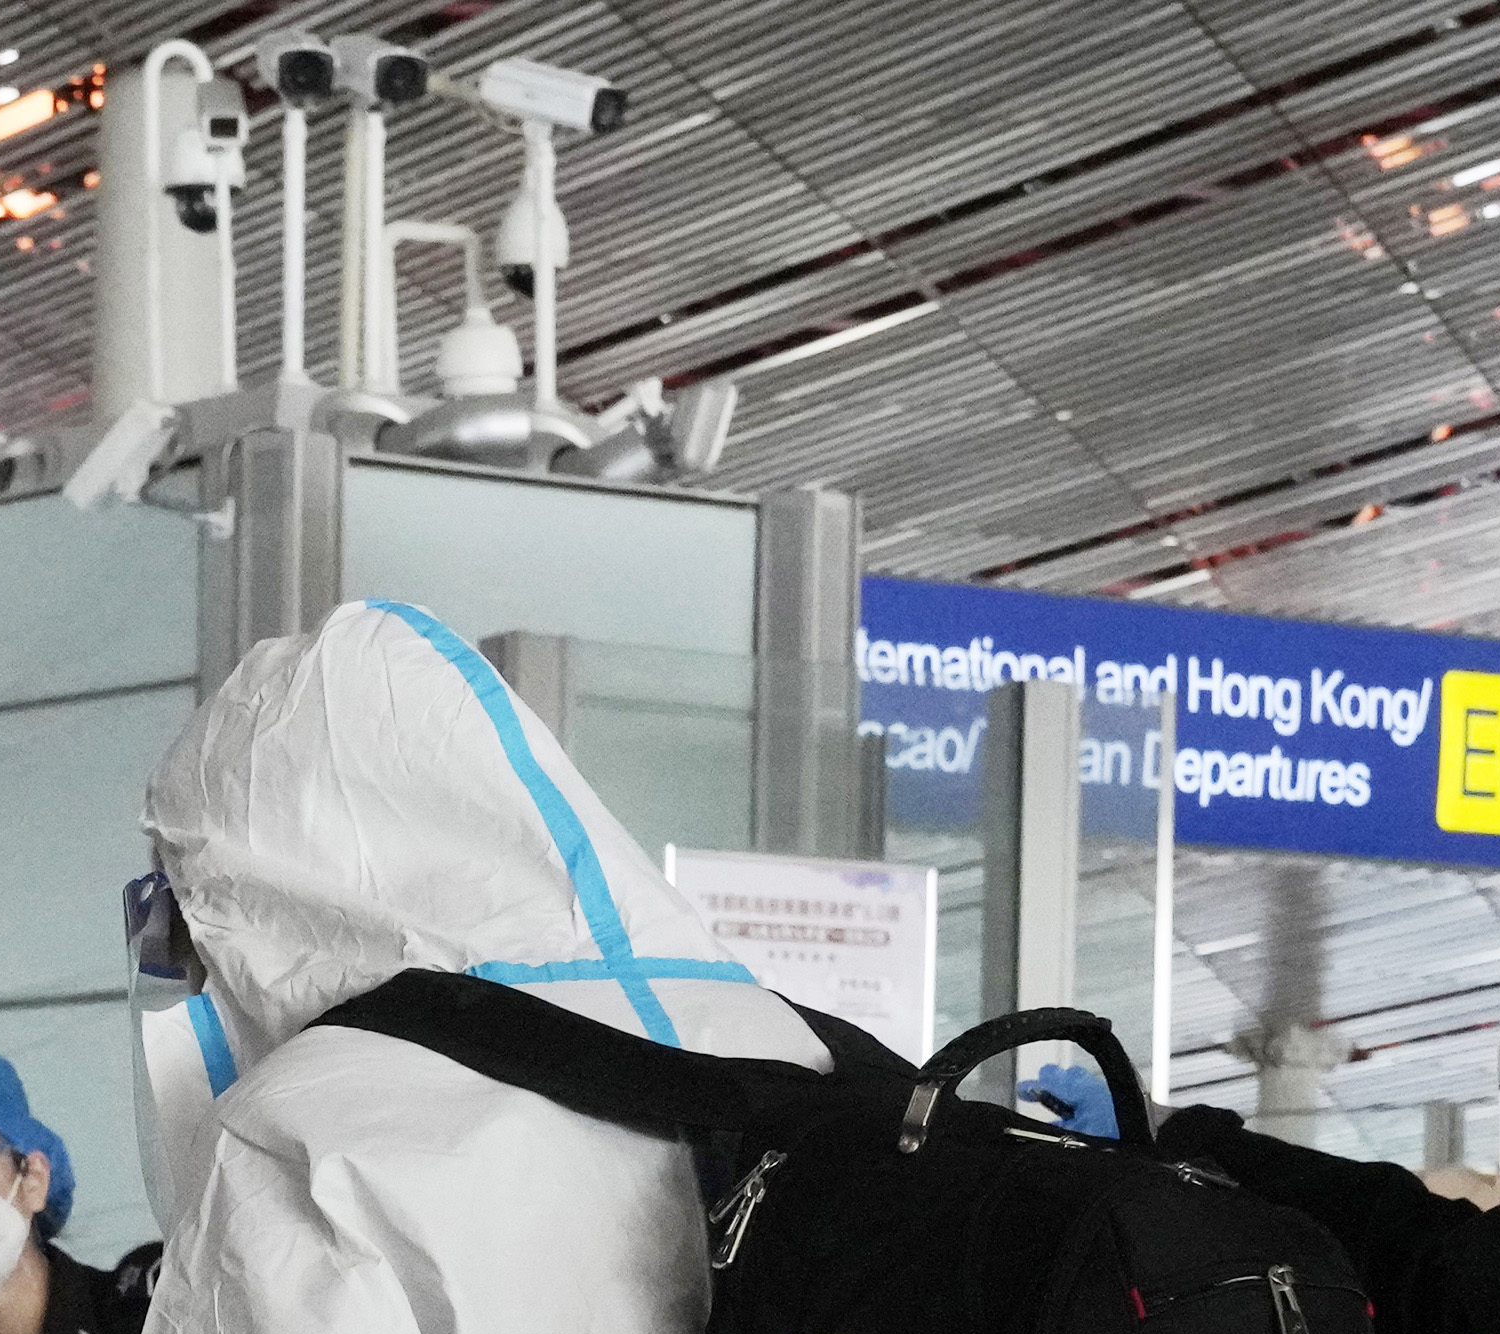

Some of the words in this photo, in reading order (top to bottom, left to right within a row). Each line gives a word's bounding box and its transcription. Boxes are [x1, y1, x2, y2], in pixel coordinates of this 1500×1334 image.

[857, 628, 1086, 692] ternational
[1096, 655, 1178, 706] and
[1188, 656, 1301, 736] Hong
[1312, 668, 1433, 746] Kong/
[1143, 731, 1372, 807] Departures
